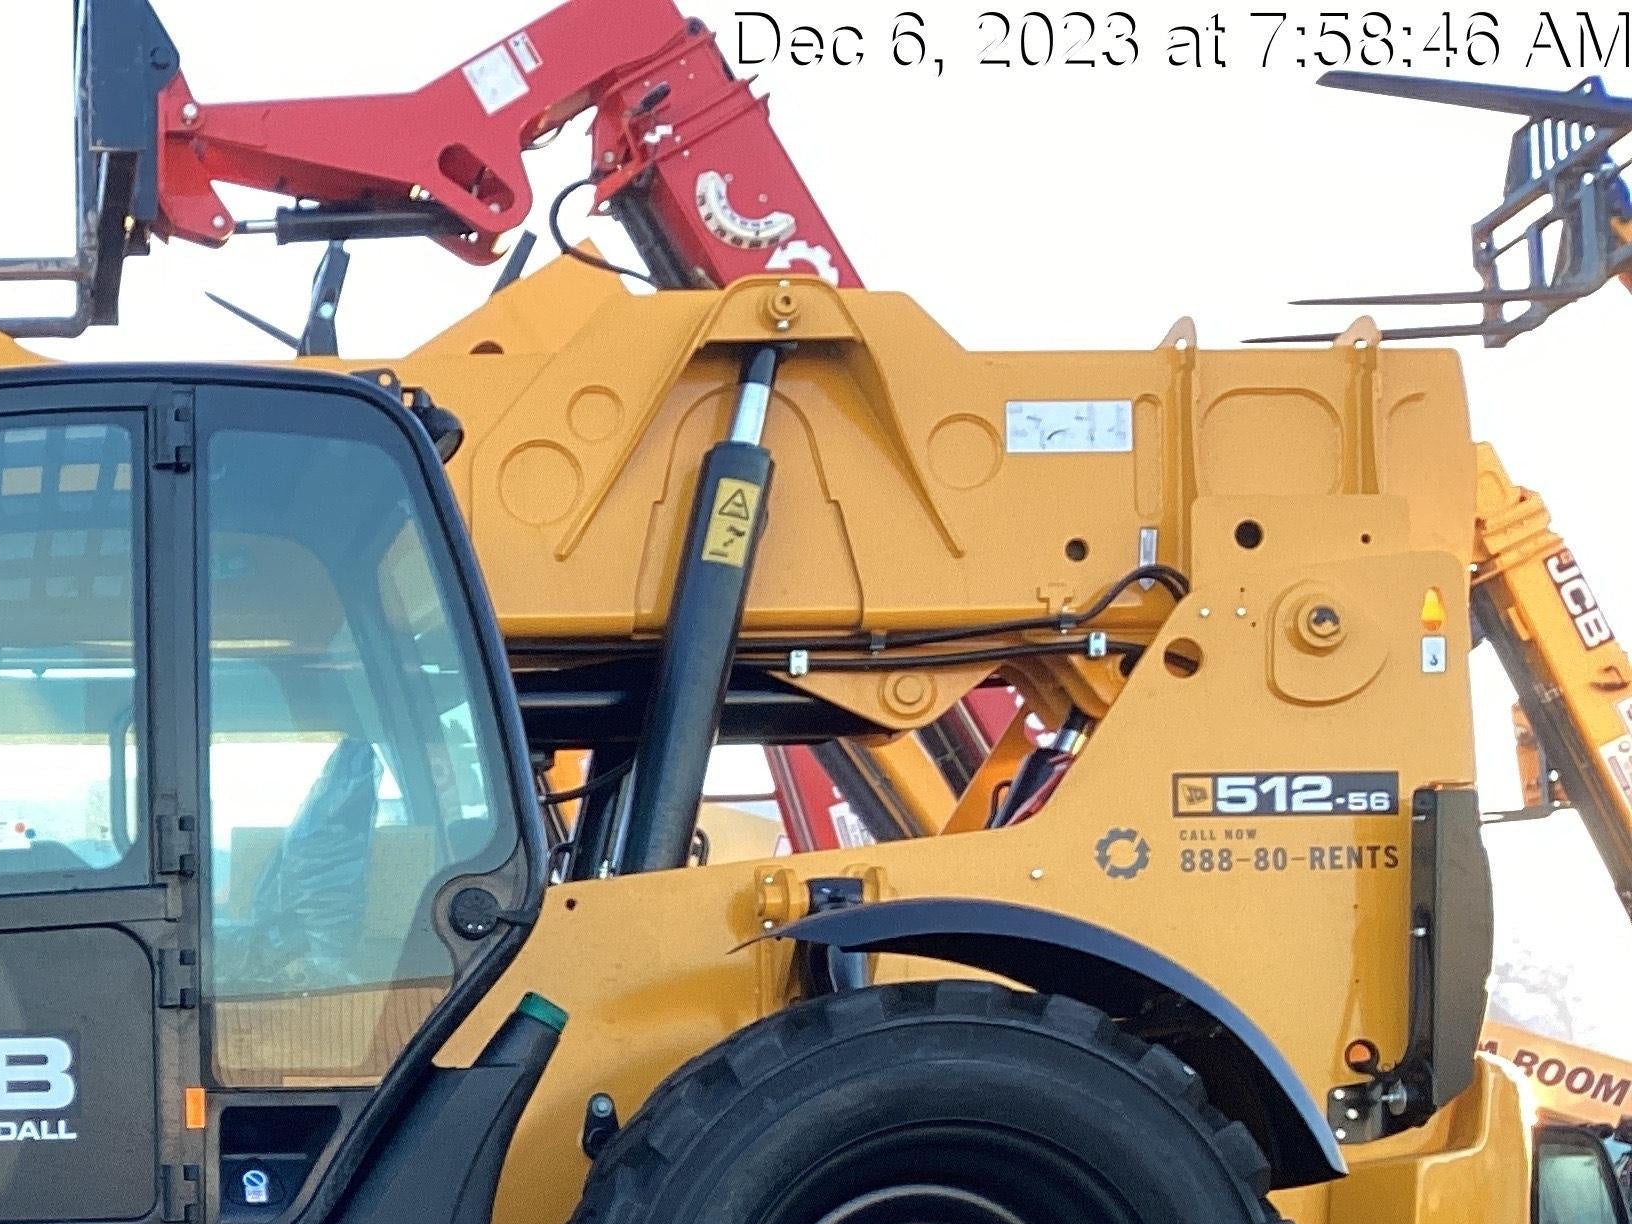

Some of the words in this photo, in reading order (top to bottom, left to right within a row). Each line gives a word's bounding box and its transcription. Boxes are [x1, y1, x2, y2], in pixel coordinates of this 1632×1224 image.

[1546, 555, 1613, 648] JCB
[1178, 829, 1217, 841] CALL
[1223, 829, 1258, 841] NOW
[1180, 845, 1399, 873] 888-80-RENTS
